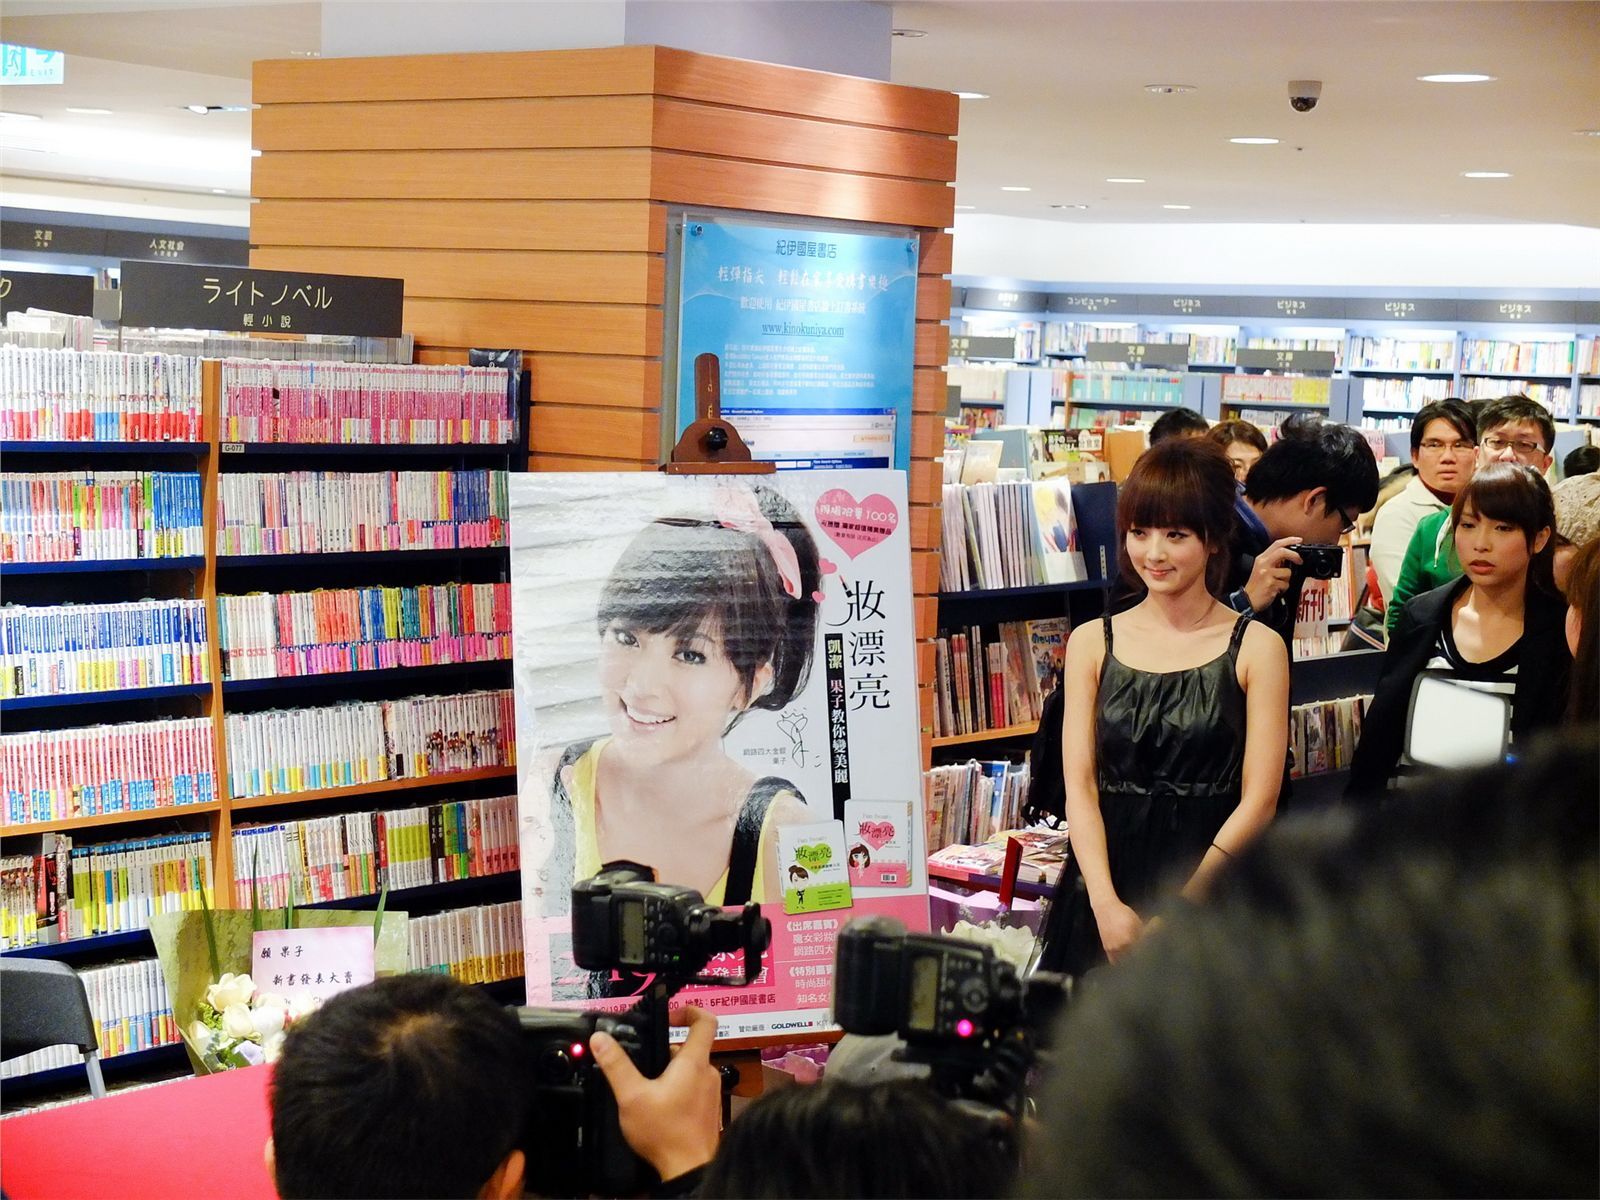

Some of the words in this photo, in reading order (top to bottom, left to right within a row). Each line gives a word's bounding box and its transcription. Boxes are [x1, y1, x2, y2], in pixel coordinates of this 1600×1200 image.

[202, 277, 334, 310] ライトノベル
[1277, 300, 1306, 310] ビジネス
[1384, 302, 1415, 312] ビジネス
[1499, 303, 1532, 314] ビジネス
[242, 312, 292, 329] 輕小說
[761, 321, 845, 338] www.kinokuniya.com
[224, 444, 243, 452] G-077
[838, 577, 891, 711] 妝漂亮
[771, 1022, 808, 1031] GOLDWELL
